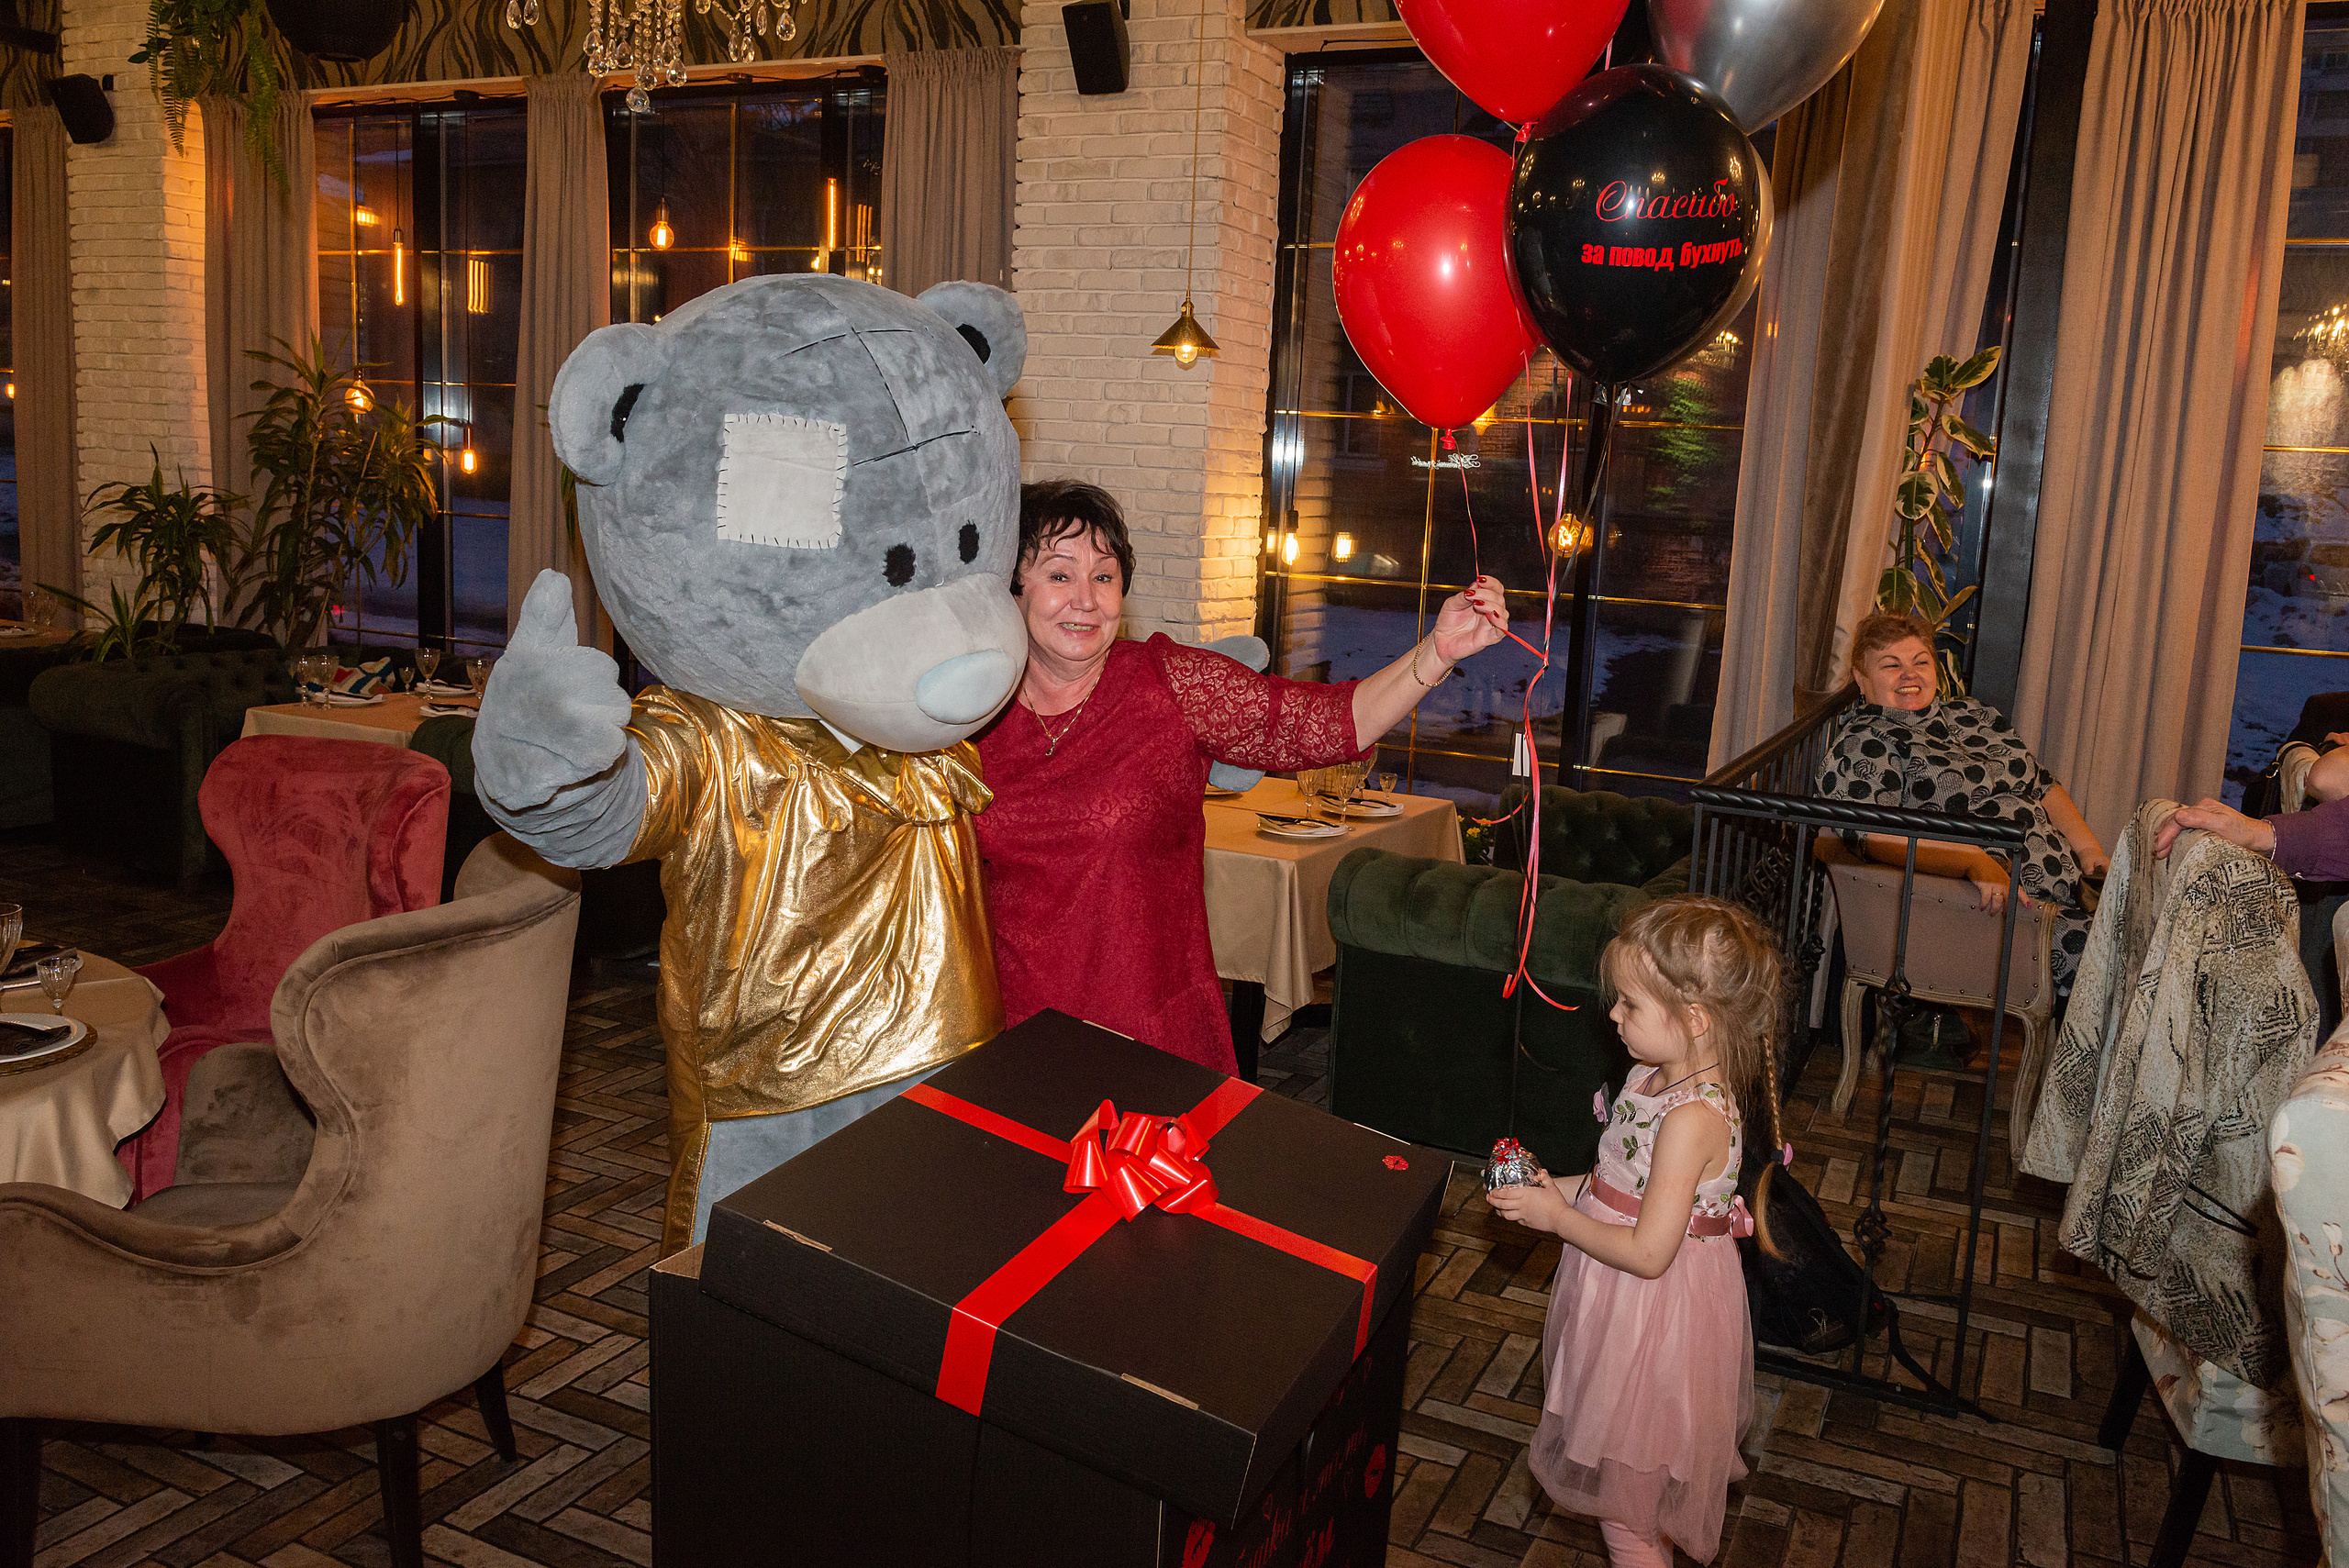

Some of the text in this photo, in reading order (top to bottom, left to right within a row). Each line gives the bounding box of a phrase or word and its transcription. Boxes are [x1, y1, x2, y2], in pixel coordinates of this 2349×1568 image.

[1596, 177, 1739, 222] Спасибо
[1581, 237, 1742, 272] за повод бухнуть
